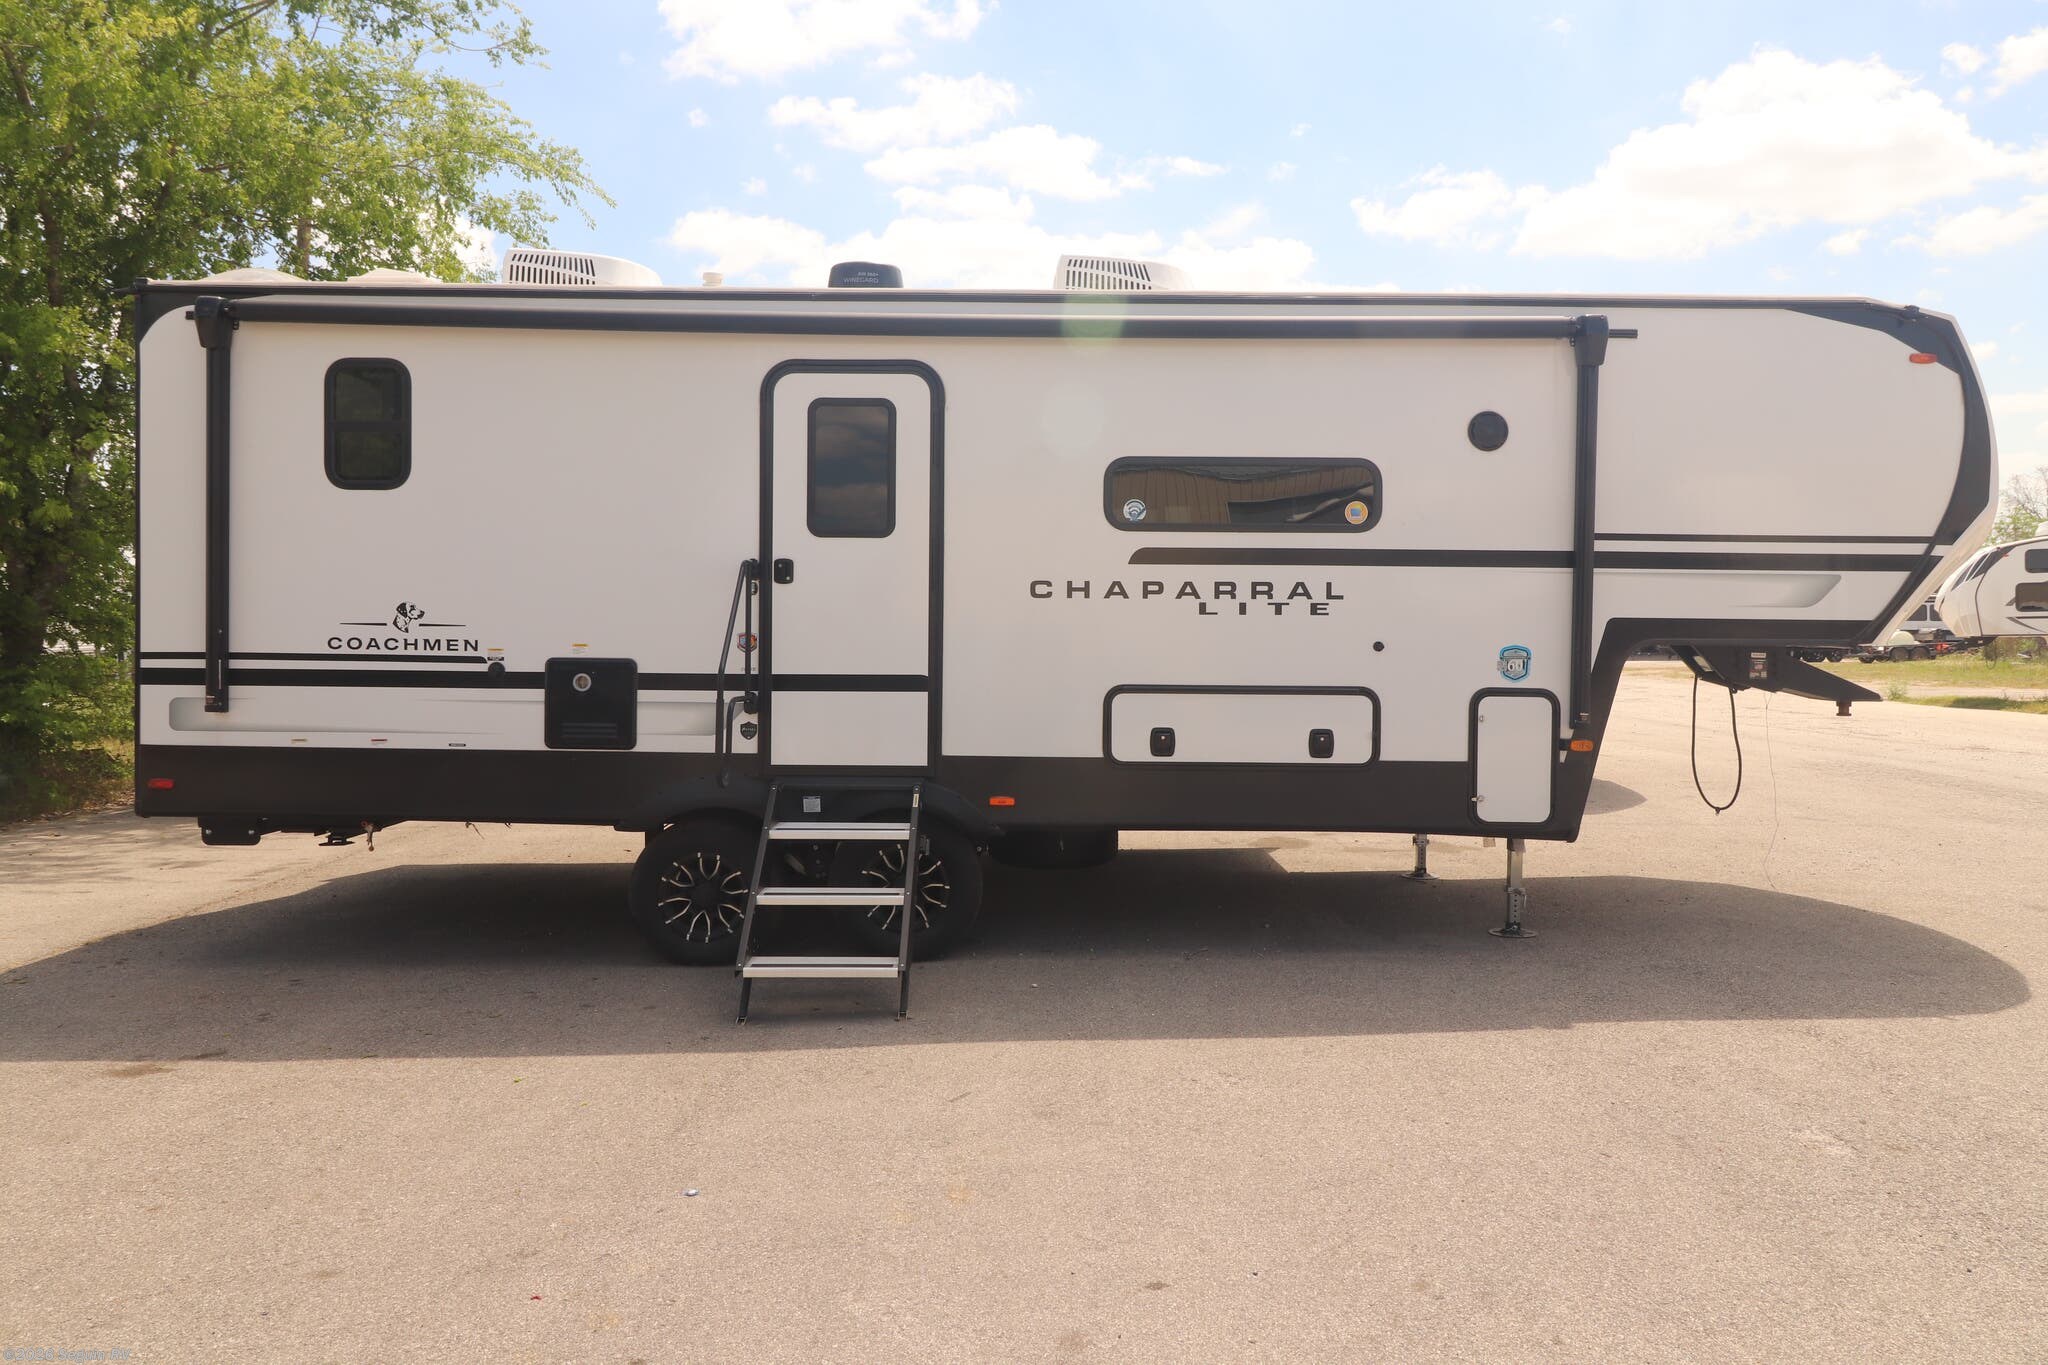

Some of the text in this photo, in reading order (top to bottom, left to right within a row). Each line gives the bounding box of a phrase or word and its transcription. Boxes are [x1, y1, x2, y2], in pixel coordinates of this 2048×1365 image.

[1029, 580, 1345, 600] CHAPARRAL
[1198, 602, 1330, 616] LITE
[327, 637, 479, 652] COACHMEN
